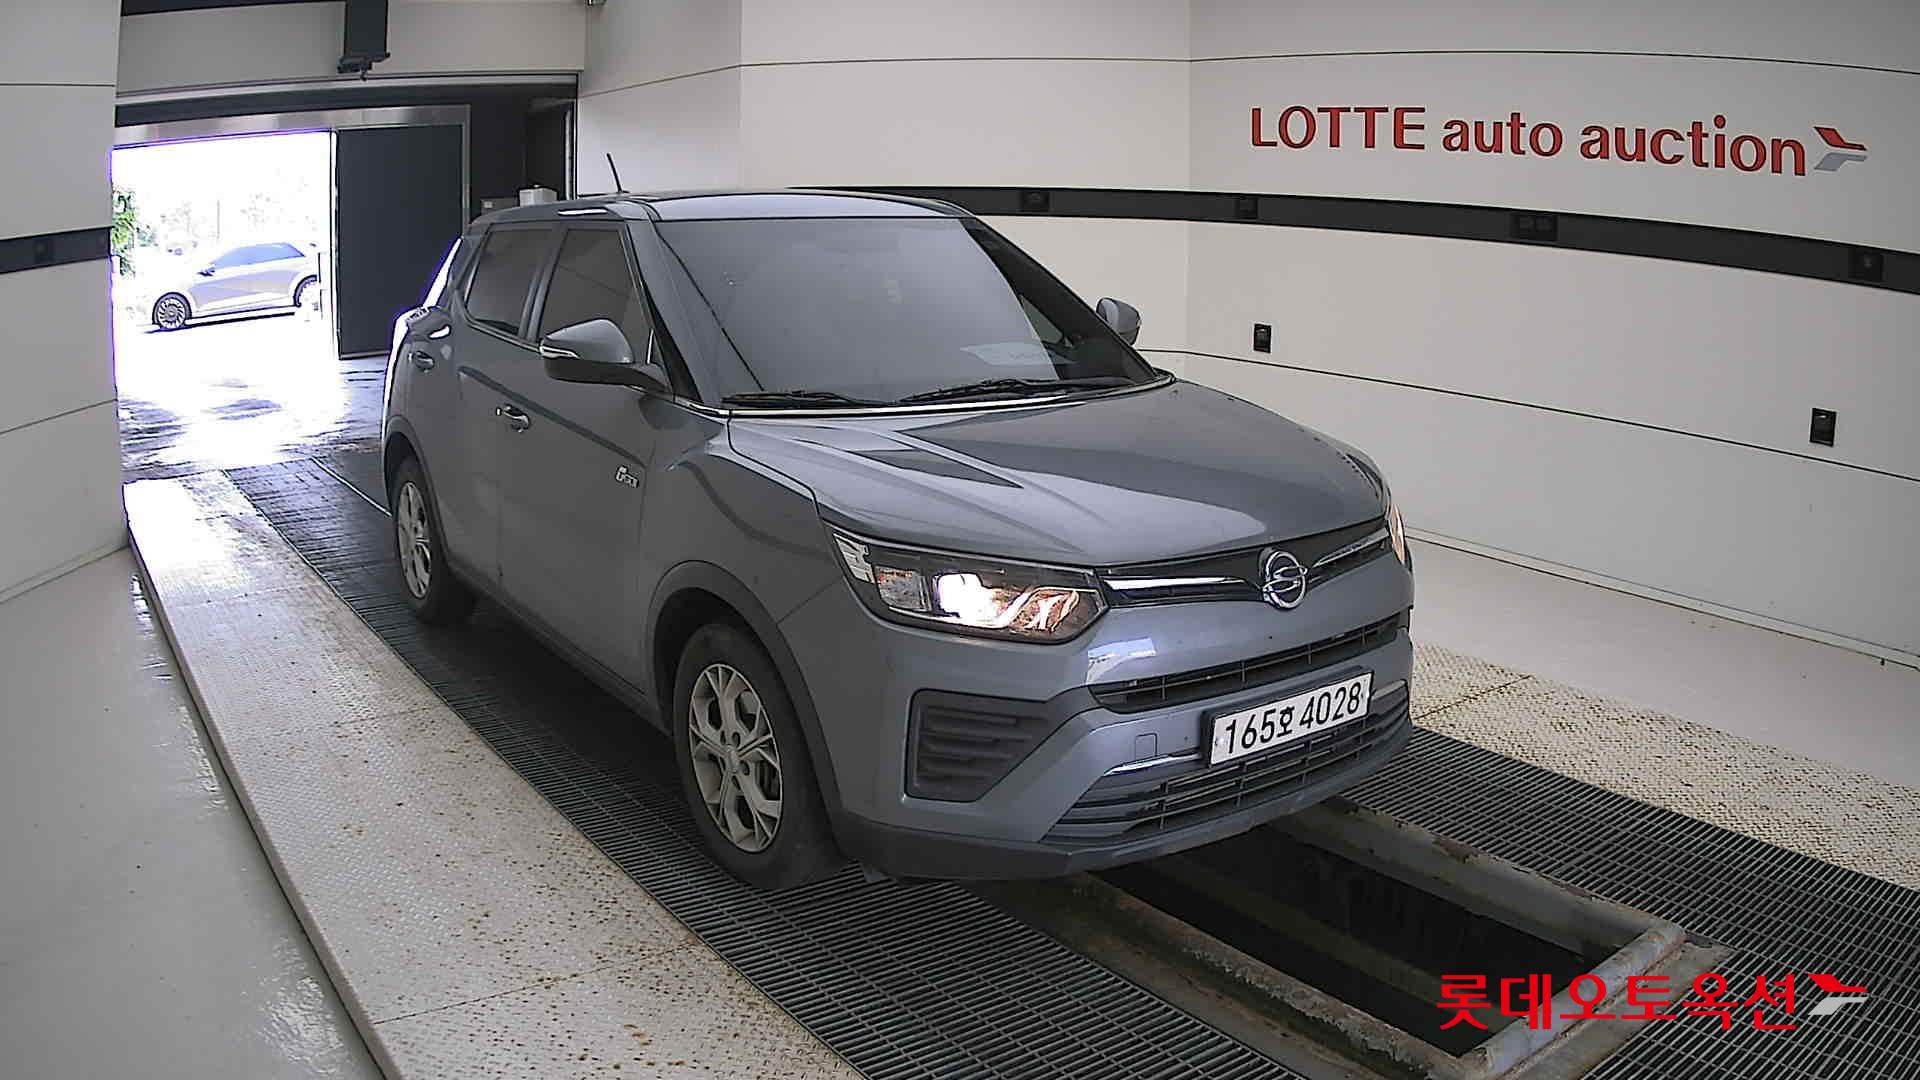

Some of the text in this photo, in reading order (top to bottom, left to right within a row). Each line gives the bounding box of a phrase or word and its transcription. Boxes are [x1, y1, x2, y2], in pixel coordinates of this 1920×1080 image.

[1251, 106, 1806, 177] LOTTE auto auction
[1225, 681, 1361, 754] 165호 4028
